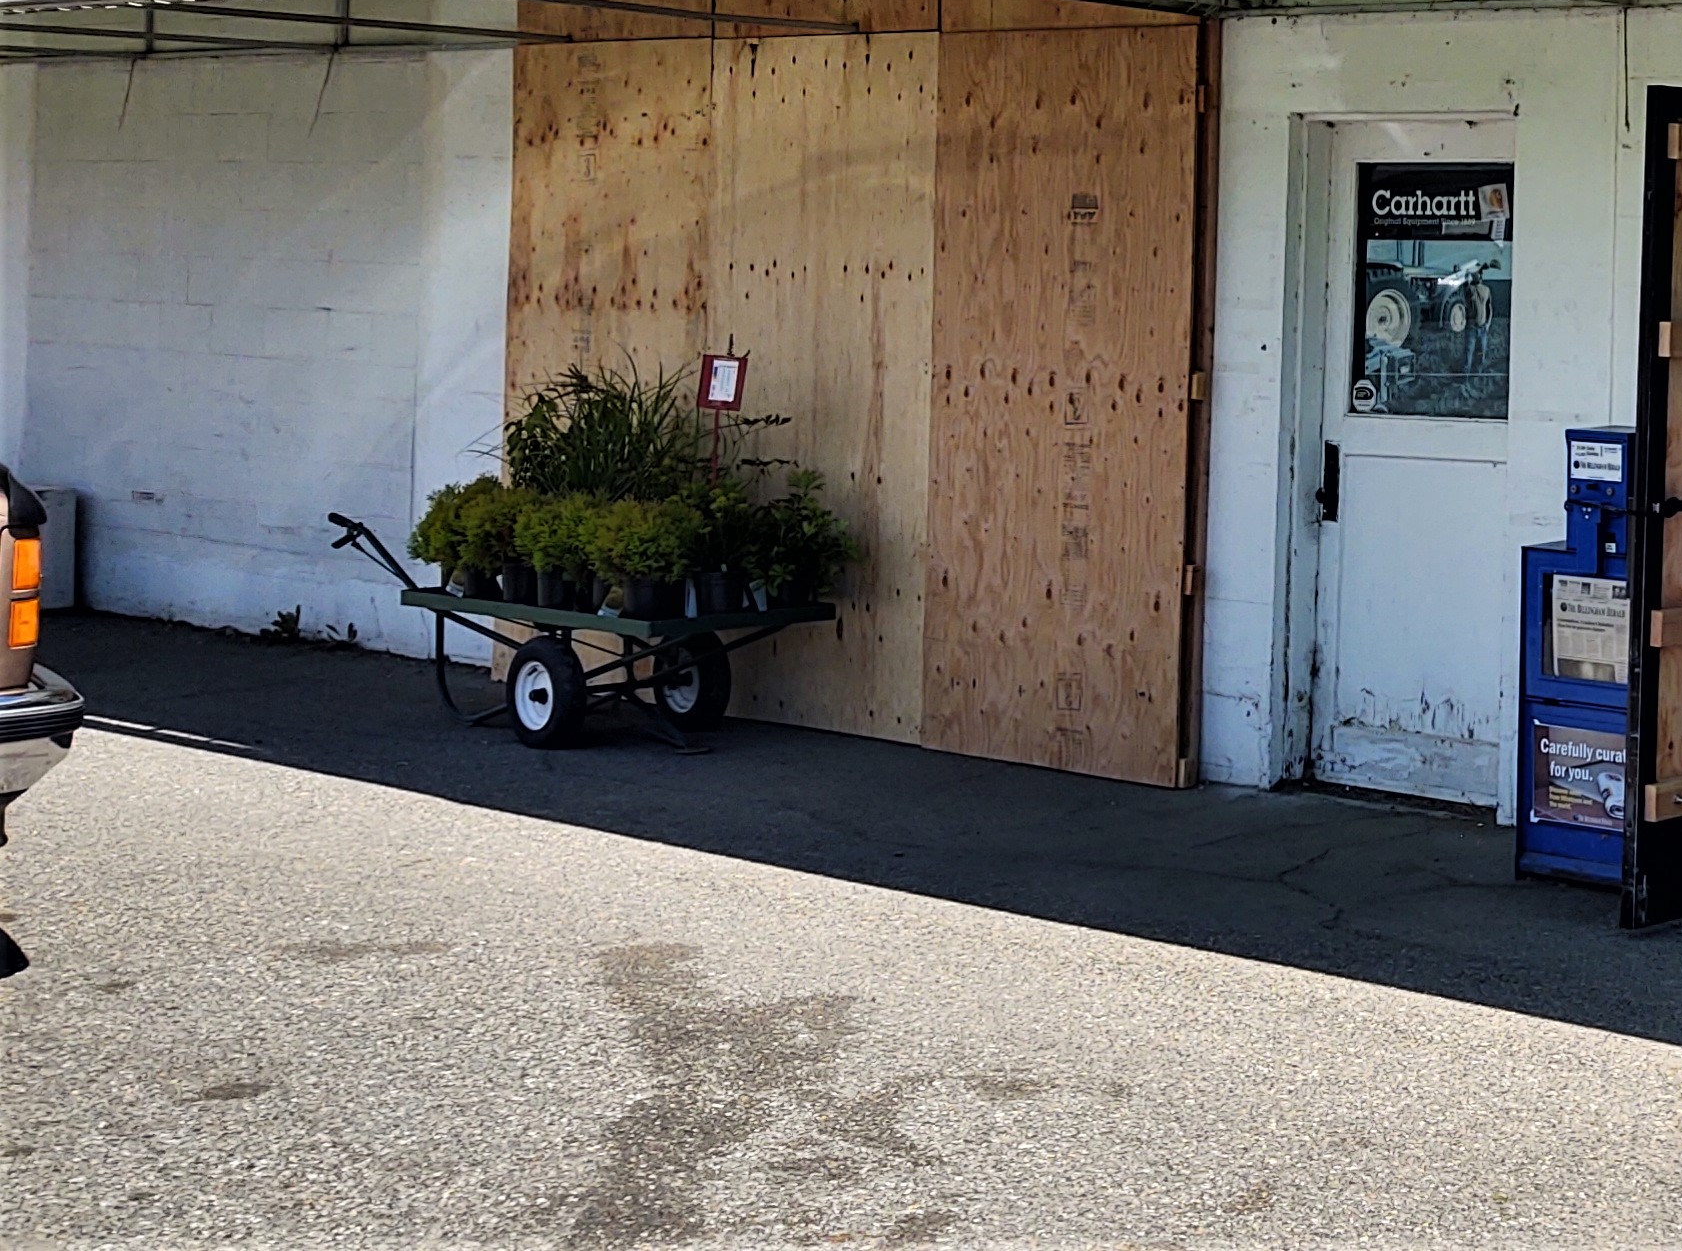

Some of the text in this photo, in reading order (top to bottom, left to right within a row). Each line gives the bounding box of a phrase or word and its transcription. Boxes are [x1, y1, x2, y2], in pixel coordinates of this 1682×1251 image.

[1371, 189, 1476, 216] Carhartt
[1540, 737, 1593, 761] Carefully
[1549, 760, 1593, 782] for you.
